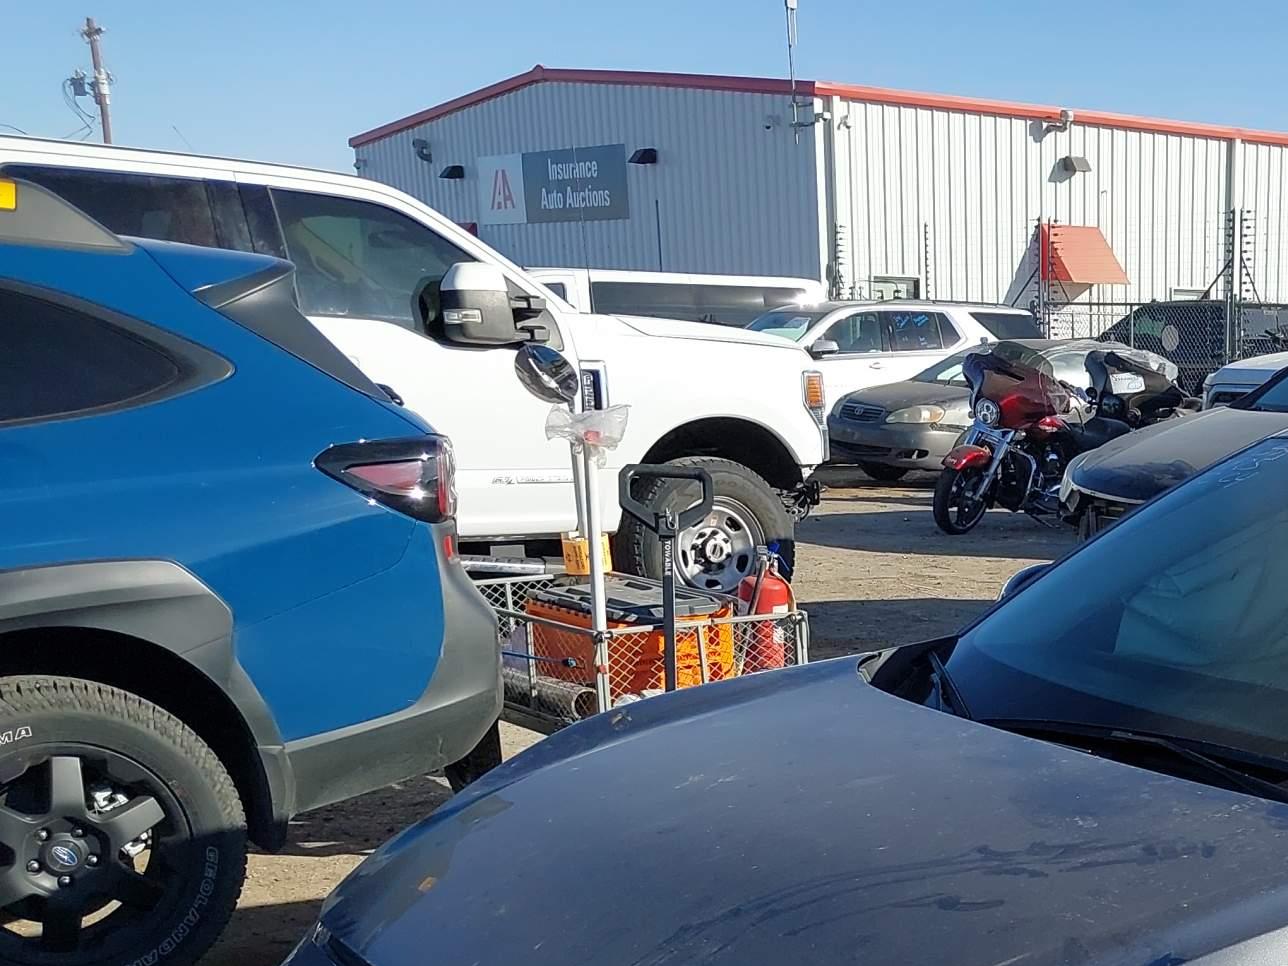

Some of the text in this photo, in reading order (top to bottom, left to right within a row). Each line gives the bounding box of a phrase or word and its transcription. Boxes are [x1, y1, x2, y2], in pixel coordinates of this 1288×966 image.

[547, 158, 599, 181] Insurance
[541, 184, 611, 209] Auto Auctions
